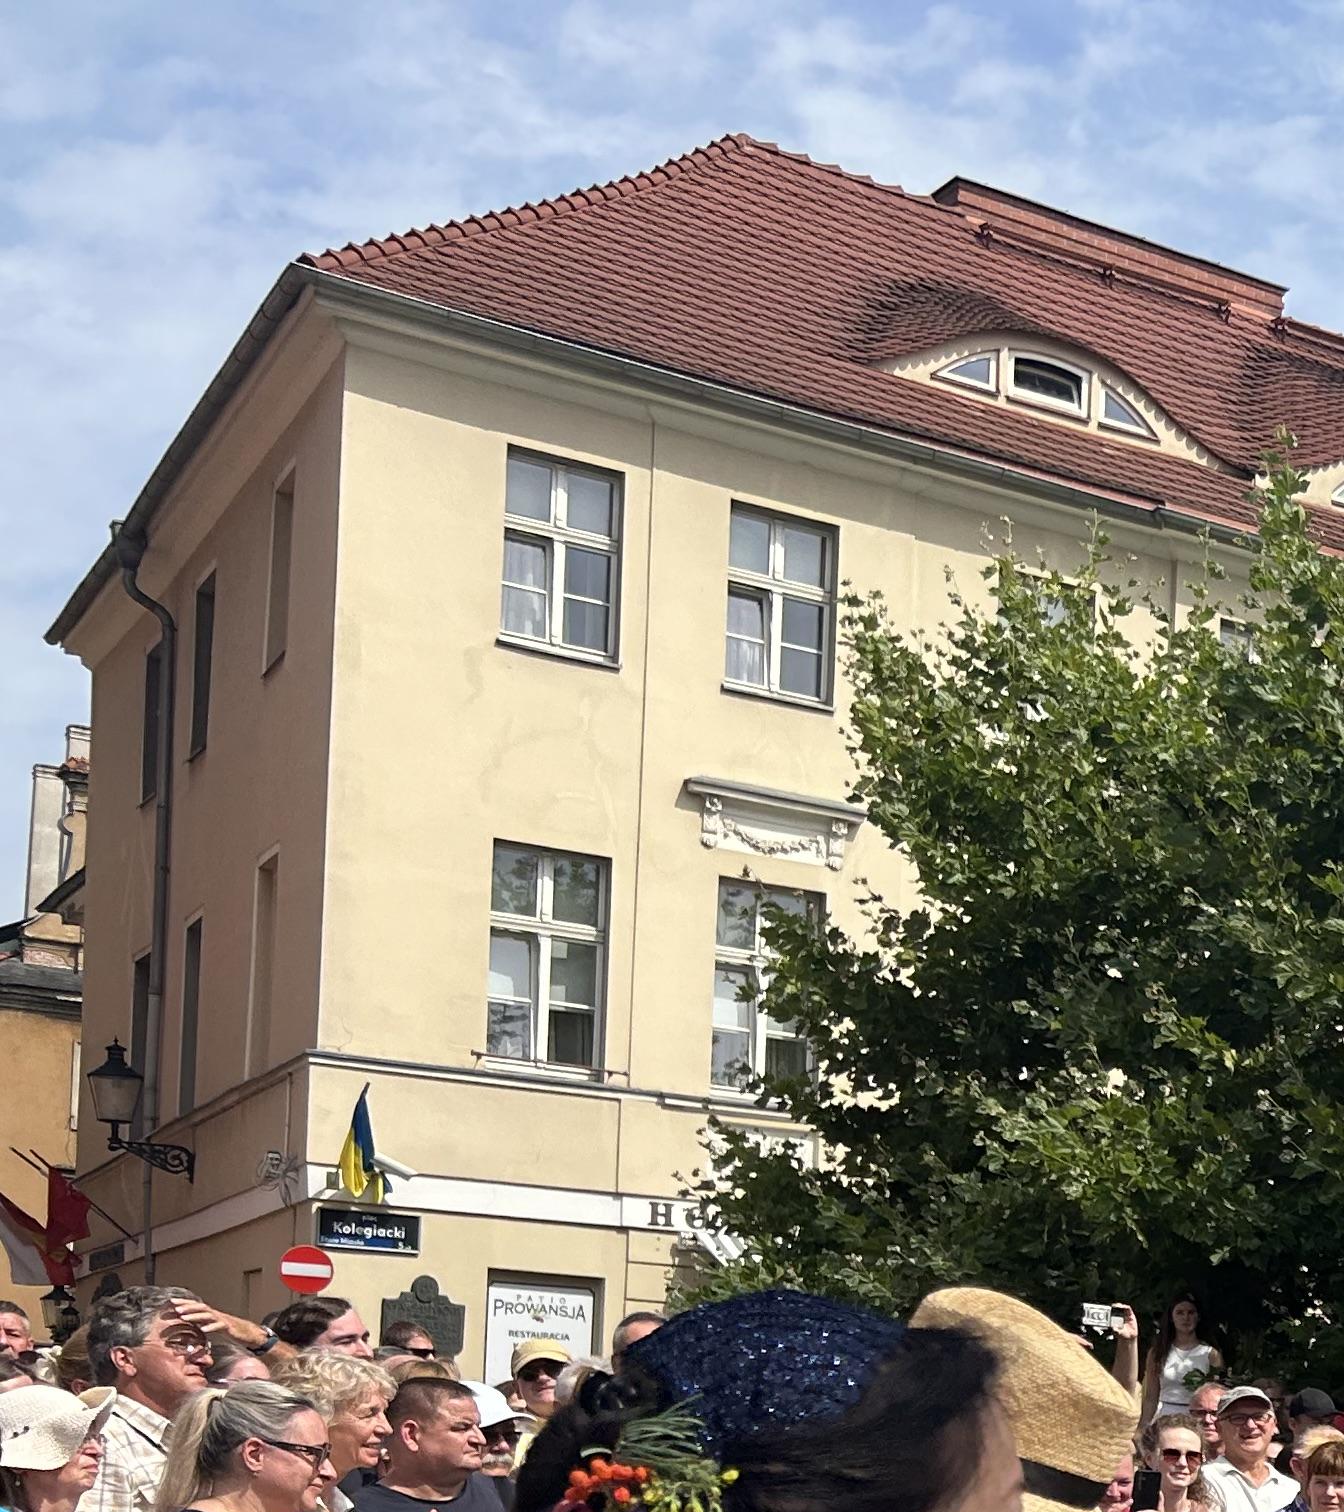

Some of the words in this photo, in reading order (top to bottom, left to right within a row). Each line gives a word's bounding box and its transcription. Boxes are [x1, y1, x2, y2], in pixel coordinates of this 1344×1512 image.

[333, 1221, 406, 1239] Kolegiacki
[516, 1294, 567, 1305] PATIO
[493, 1298, 586, 1323] PROWANSJA
[508, 1329, 570, 1341] RESTAURACJA
